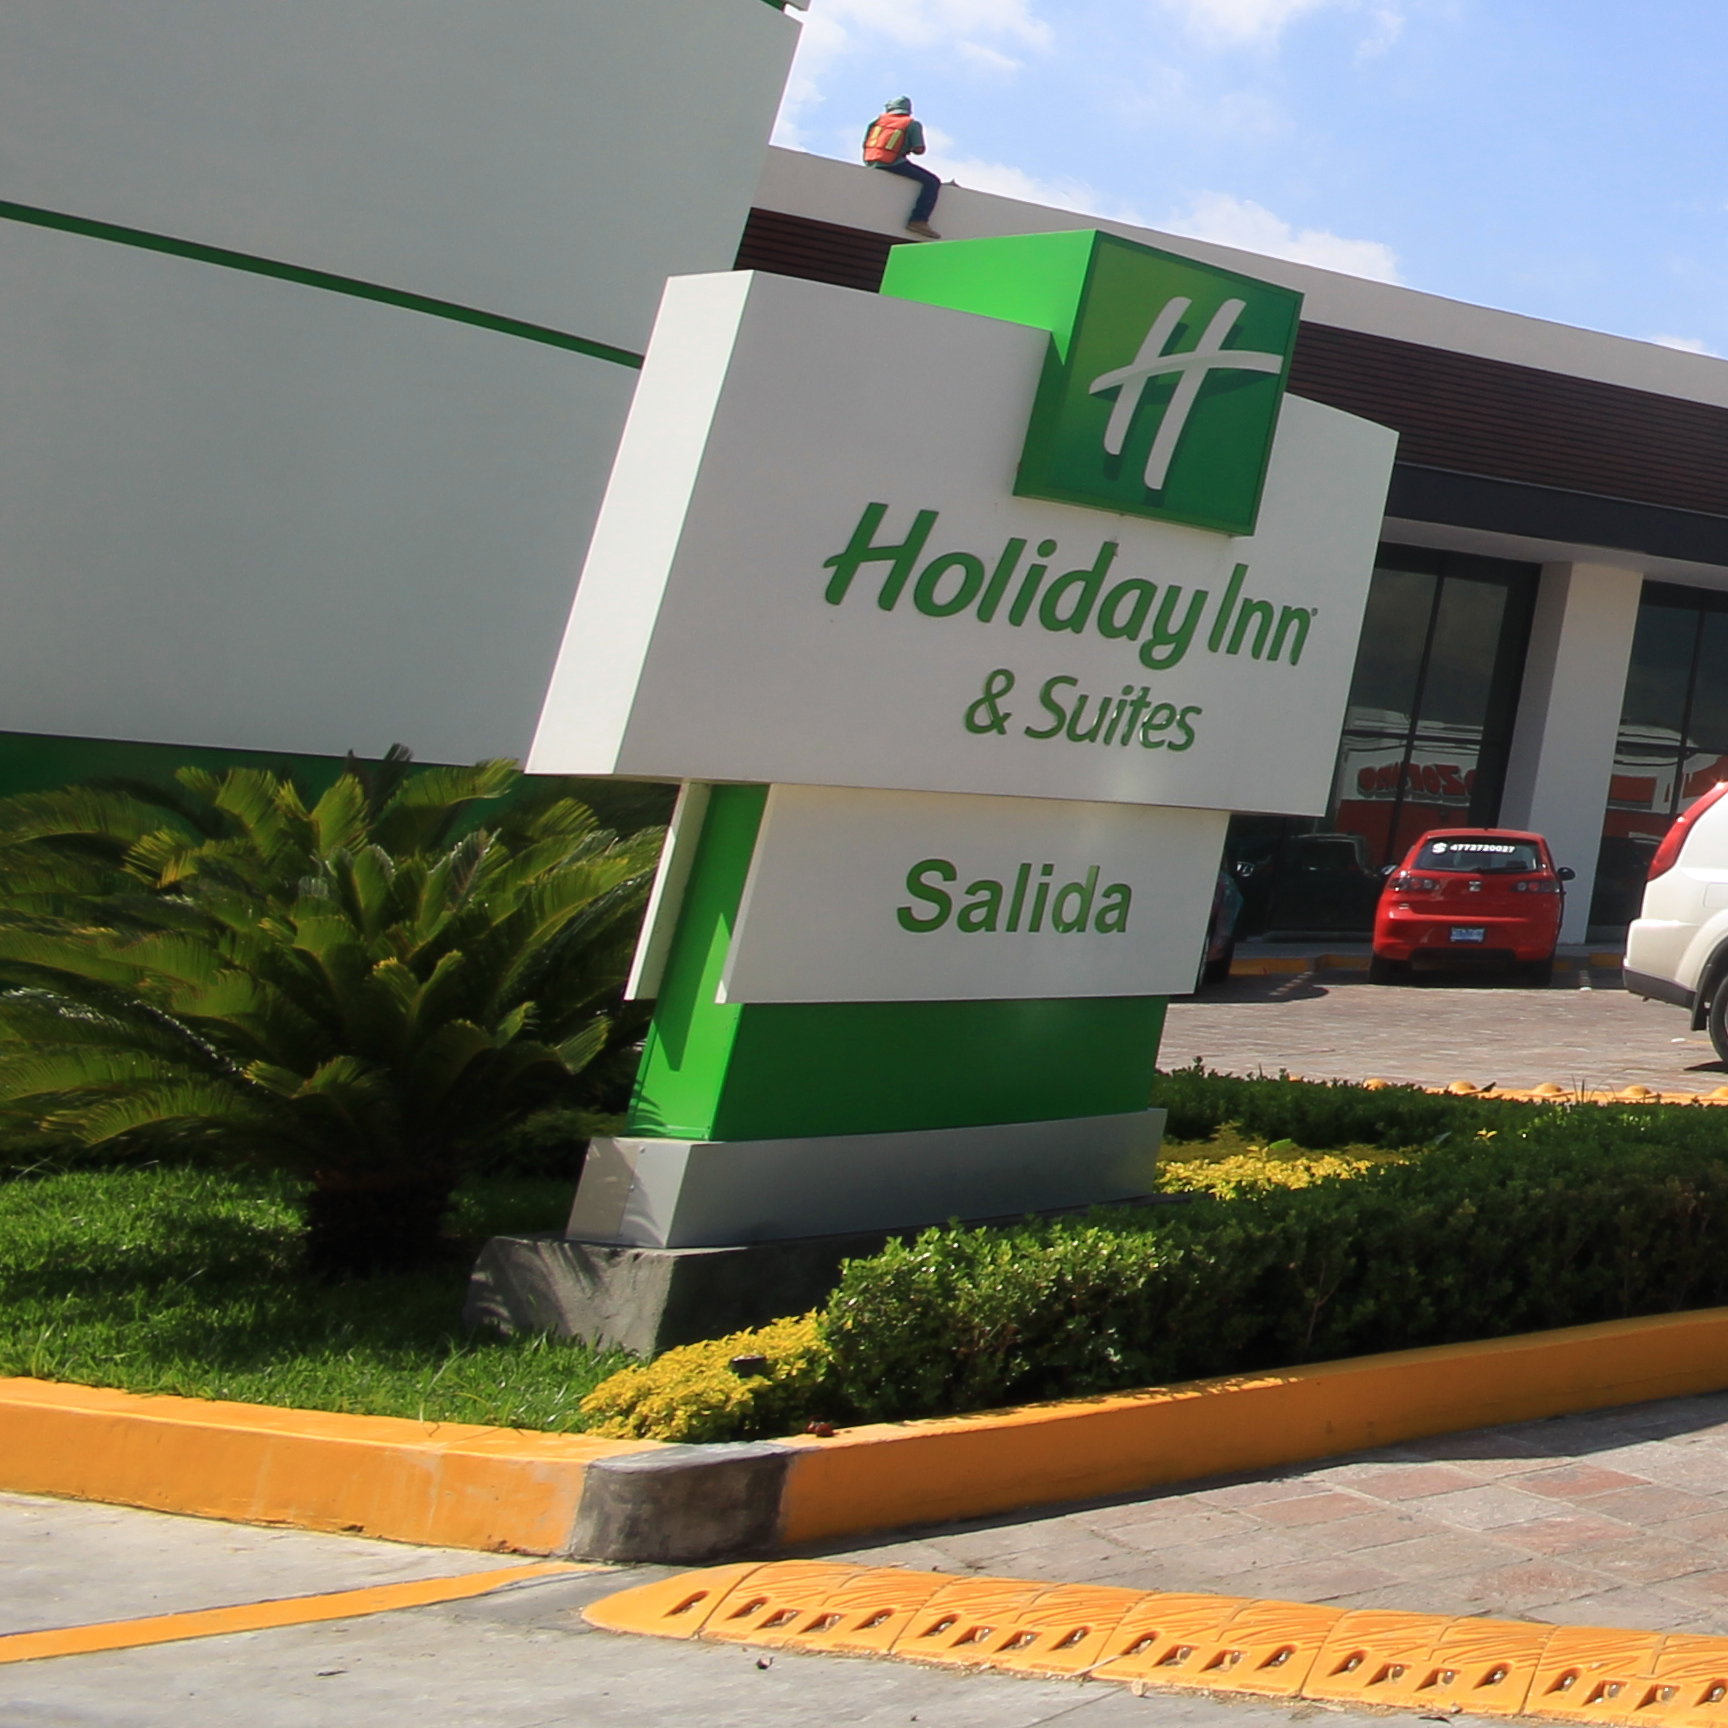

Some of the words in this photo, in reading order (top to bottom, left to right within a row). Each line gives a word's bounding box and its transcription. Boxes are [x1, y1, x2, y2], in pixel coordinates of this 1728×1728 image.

[823, 501, 1208, 671] Holiday
[1208, 563, 1313, 667] Inn
[964, 668, 1015, 735] &
[1024, 675, 1203, 752] Suites
[895, 859, 1133, 935] Salida
